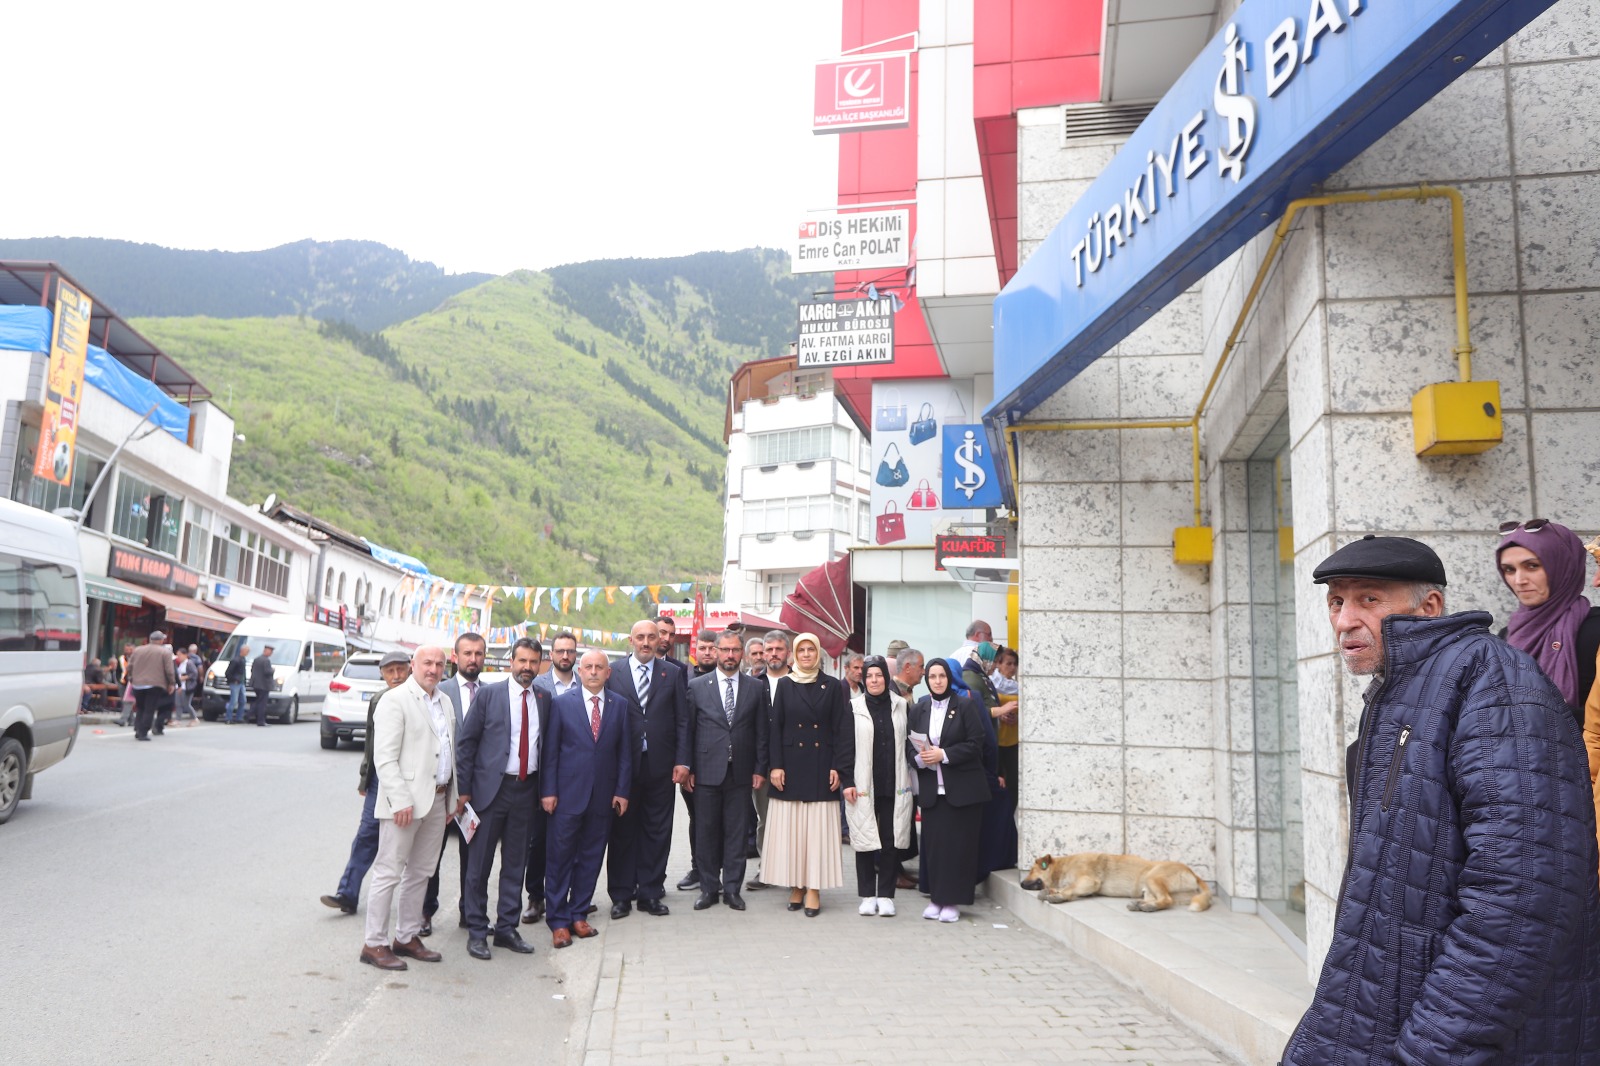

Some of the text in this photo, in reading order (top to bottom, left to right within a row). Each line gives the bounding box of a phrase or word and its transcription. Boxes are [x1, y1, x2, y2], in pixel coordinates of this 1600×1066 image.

[815, 106, 904, 124] MAÇKA İLÇE BAŞKANLIĞI
[1070, 110, 1209, 287] TÜRKİYE
[1264, 0, 1363, 98] BA
[798, 237, 901, 259] Emre Can POLAT
[799, 299, 891, 321] KARGI AKIN
[801, 318, 890, 333] HUKUK BÜROSU
[801, 332, 890, 348] AV. FATMA KARGI
[804, 347, 887, 363] AV. EZGİ AKIN
[941, 537, 997, 553] KUAFÖR
